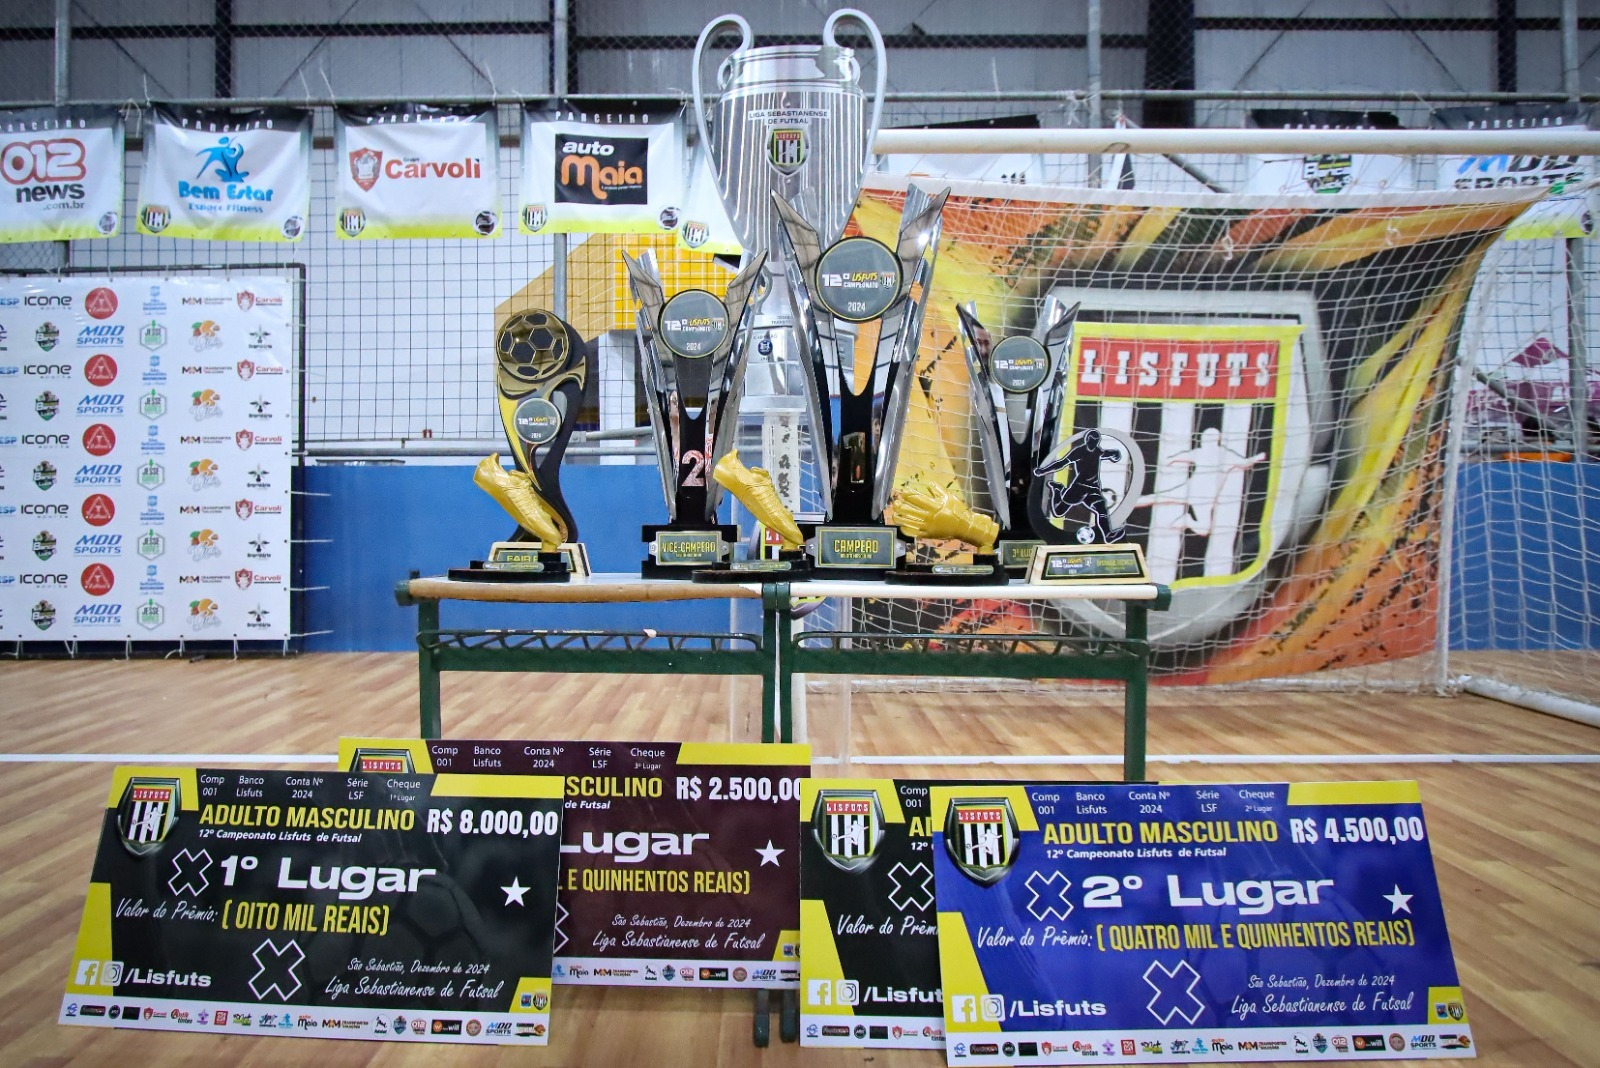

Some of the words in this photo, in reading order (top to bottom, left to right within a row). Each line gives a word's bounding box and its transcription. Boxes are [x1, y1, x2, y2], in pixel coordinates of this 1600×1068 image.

[182, 118, 273, 132] PARCEIRO
[556, 111, 650, 124] PARCEIRO
[1468, 116, 1563, 130] PARCEIRO
[562, 141, 614, 156] auto
[0, 138, 86, 185] 012
[384, 158, 480, 179] Carvoli
[561, 154, 643, 200] Maia
[16, 183, 86, 203] news
[178, 181, 220, 200] Bem
[226, 184, 274, 201] Estar
[44, 200, 86, 210] .com.br
[848, 302, 866, 312] 2024
[78, 325, 124, 336] MDD
[686, 342, 701, 350] 2024
[1081, 349, 1270, 387] LISFUTS
[682, 450, 704, 486] 2
[834, 538, 878, 553] CAMPEÃO
[76, 604, 122, 615] MDD
[74, 616, 121, 624] SPORTS
[432, 746, 458, 756] Comp
[474, 746, 501, 755] Banco
[524, 746, 550, 756] Conta
[589, 747, 612, 756] Série
[630, 748, 666, 758] Cheque
[362, 760, 402, 770] LISFUTS
[436, 758, 453, 767] 001
[474, 758, 502, 768] Lisfuts
[532, 760, 554, 768] 2024
[592, 760, 608, 768] LSF
[643, 762, 661, 770] Lugar
[200, 775, 225, 784] Comp
[239, 776, 264, 785] Banco
[286, 777, 310, 786] Conta
[347, 778, 369, 788] Série
[387, 779, 421, 789] Cheque
[564, 776, 662, 798] SCULINO
[676, 776, 702, 801] R$
[133, 790, 171, 799] LISFUTS
[202, 788, 218, 796] 001
[236, 788, 263, 798] Lisfuts
[292, 790, 313, 798] 2024
[348, 791, 364, 800] LSF
[900, 786, 928, 797] Comp
[1032, 792, 1060, 802] Comp
[1076, 792, 1105, 801] Banco
[1128, 791, 1156, 800] Conta
[1196, 790, 1220, 799] Série
[1238, 790, 1274, 800] Cheque
[565, 801, 578, 809] de
[580, 800, 611, 810] Futsal
[826, 803, 869, 812] LISFUTS
[905, 799, 922, 808] 001
[1038, 806, 1055, 814] 001
[1076, 805, 1107, 814] Lisfuts
[1139, 805, 1162, 813] 2024
[1201, 804, 1218, 812] LSF
[1254, 805, 1272, 814] Lugar
[199, 804, 281, 827] ADULTO
[285, 806, 415, 830] MASCULINO
[426, 808, 454, 835] R$
[460, 809, 558, 839] 8.000,00
[958, 811, 1001, 821] LISFUTS
[199, 829, 215, 838] 12º
[216, 829, 276, 842] Campeonato
[278, 831, 311, 842] Lisfuts
[317, 832, 329, 842] de
[332, 833, 362, 843] Futsal
[1043, 823, 1133, 845] ADULTO
[1139, 820, 1278, 844] MASCULINO
[1289, 817, 1319, 844] R$
[1324, 816, 1424, 845] 4.500,00
[910, 842, 928, 851] 12º
[1046, 849, 1064, 859] 12º
[1066, 849, 1134, 860] Campeonato
[1137, 848, 1173, 858] Lisfuts
[1178, 848, 1192, 857] de
[1194, 847, 1226, 857] Futsal
[220, 855, 258, 886] 1º
[277, 856, 436, 900] Lugar
[568, 869, 578, 890] E
[582, 869, 689, 892] QUINHENTOS
[694, 871, 750, 894] REAIS)
[1082, 875, 1143, 908] 2º
[1166, 874, 1334, 916] Lugar
[115, 898, 149, 919] Valor
[152, 901, 167, 917] do
[170, 900, 218, 923] Prêmio:
[235, 902, 279, 930] OITO
[283, 904, 318, 932] MIL
[322, 904, 390, 936] REAIS)
[612, 914, 627, 926] São
[630, 914, 668, 929] Sebastião,
[674, 916, 713, 928] Dezembro
[716, 917, 724, 928] de
[727, 918, 751, 928] 2024
[837, 914, 874, 936] Valor
[879, 916, 894, 935] do
[592, 930, 616, 952] Liga
[622, 930, 700, 948] Sebastianense
[705, 934, 718, 948] de
[724, 932, 766, 949] Futsal
[978, 927, 1015, 948] Valor
[1020, 928, 1035, 946] do
[1041, 926, 1092, 947] Prêmio:
[1109, 924, 1180, 952] QUATRO
[1184, 924, 1218, 948] MIL
[1221, 924, 1234, 948] E
[1237, 922, 1350, 950] QUINHENTOS
[1353, 919, 1415, 946] REAIS)
[347, 958, 363, 971] São
[366, 958, 405, 975] Sebastião,
[410, 960, 450, 974] Dezembro
[452, 962, 462, 974] de
[465, 963, 490, 974] 2024
[124, 968, 212, 987] /Lisfuts
[1248, 974, 1264, 988] São
[1266, 974, 1309, 990] Sebastião,
[1314, 974, 1355, 988] Dezembro
[1358, 975, 1368, 986] de
[1372, 975, 1395, 986] 2024
[325, 976, 350, 1000] Liga
[355, 975, 435, 998] Sebastianense
[440, 981, 453, 997] de
[459, 977, 504, 999] Futsal
[1010, 1000, 1107, 1018] /Lisfuts
[1231, 995, 1257, 1020] Liga
[1262, 994, 1347, 1013] Sebastianense
[1352, 994, 1366, 1011] de
[1372, 991, 1414, 1012] Futsal
